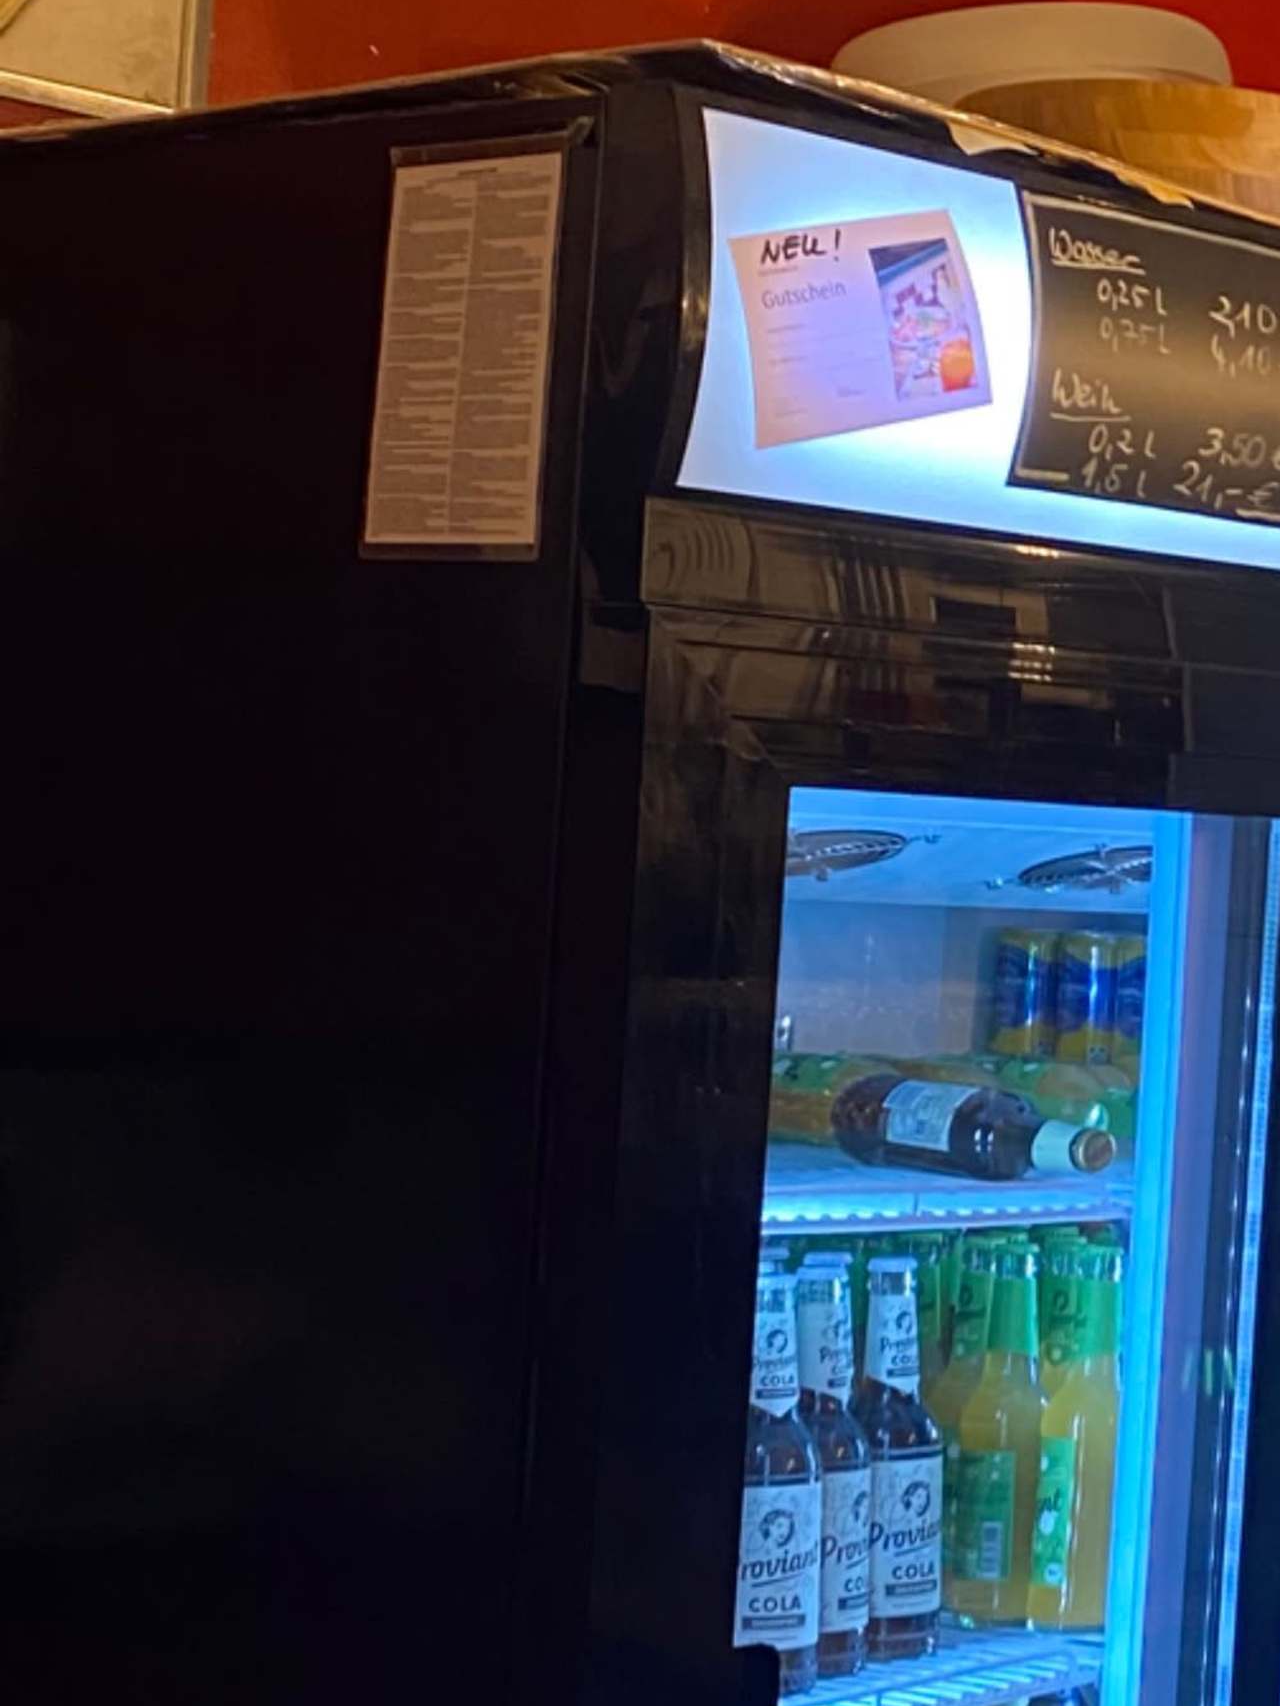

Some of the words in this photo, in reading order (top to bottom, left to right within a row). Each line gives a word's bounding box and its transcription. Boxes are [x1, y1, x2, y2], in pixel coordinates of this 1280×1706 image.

[761, 279, 848, 310] Gutschein
[1052, 367, 1122, 415] Wein
[892, 1561, 934, 1580] COLA
[749, 1596, 802, 1613] COLA
